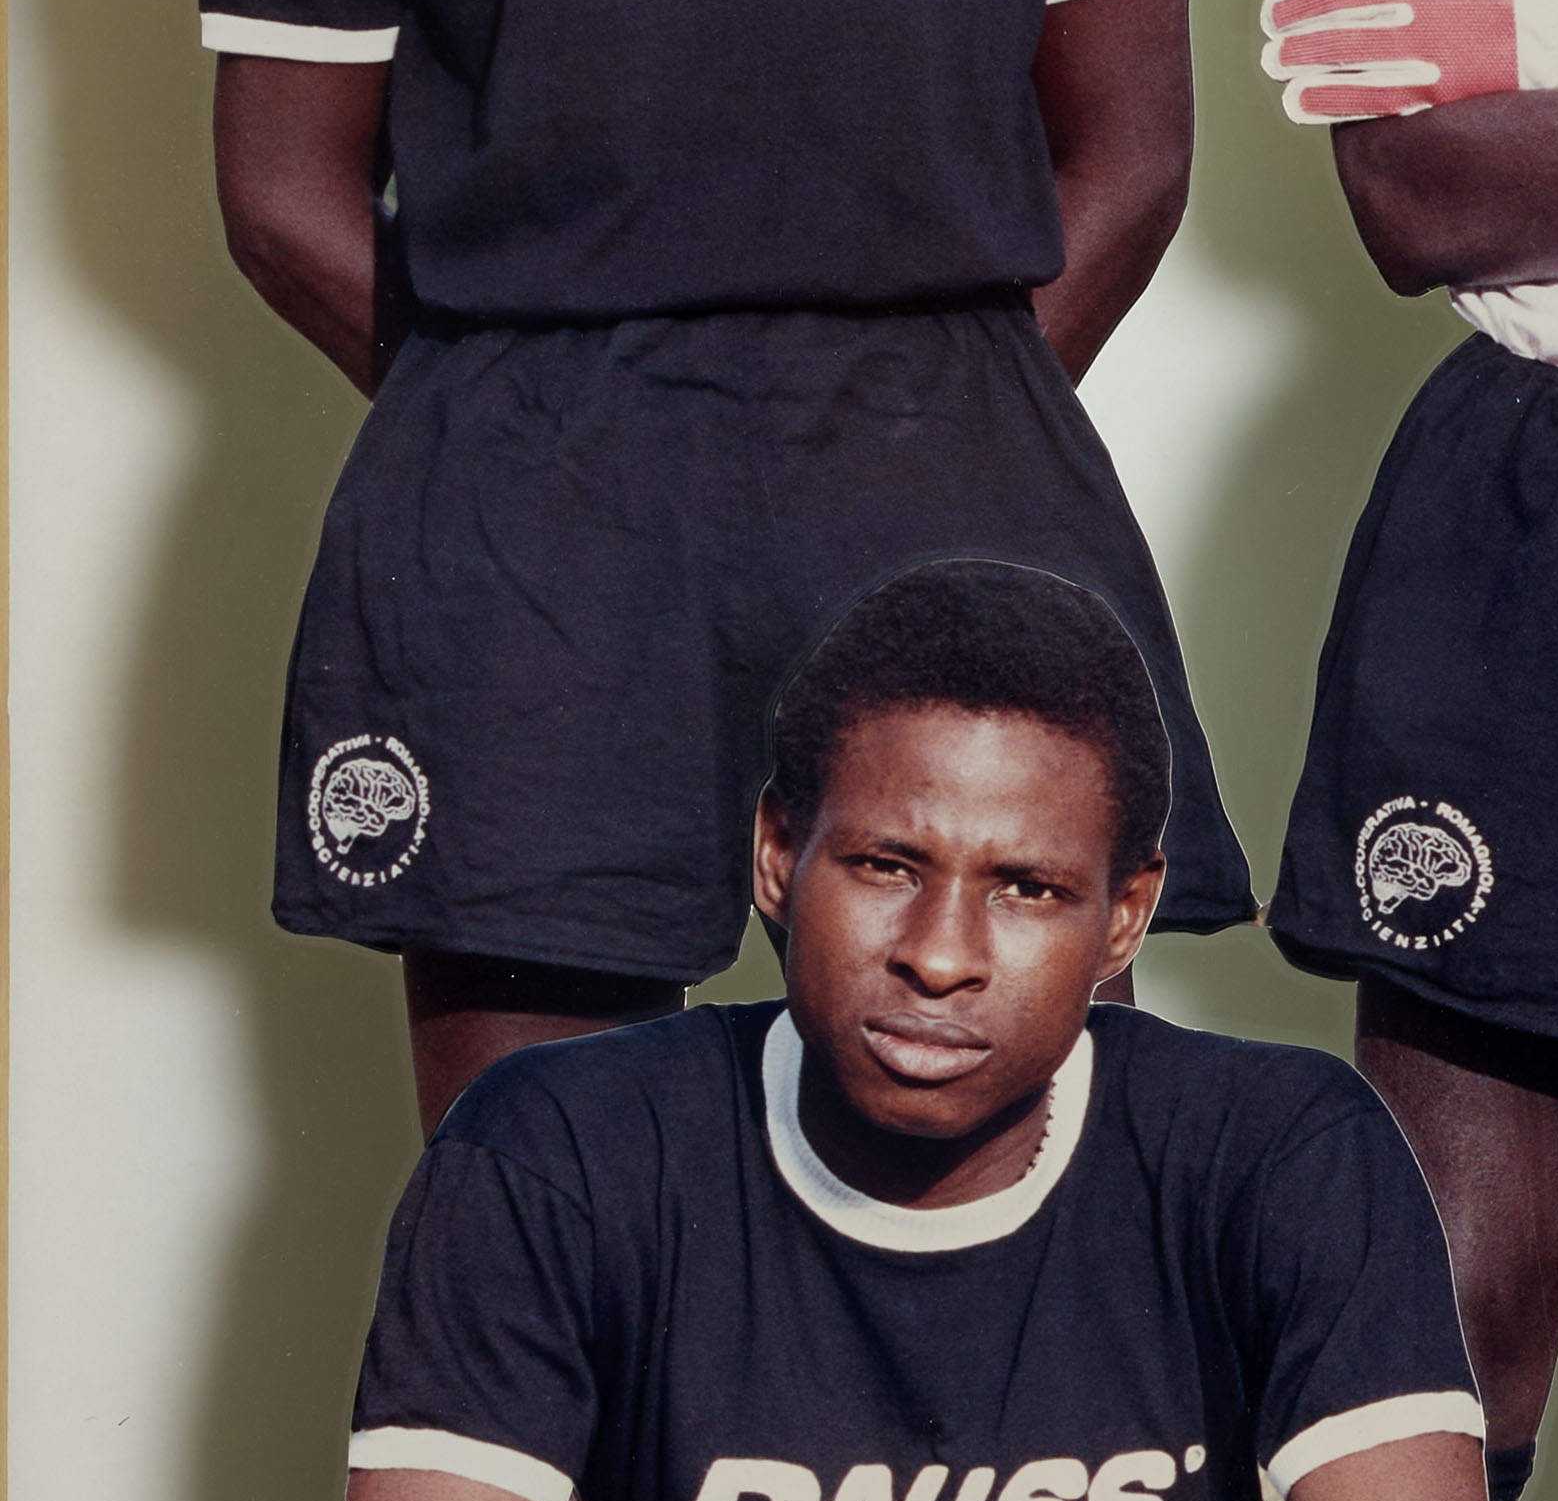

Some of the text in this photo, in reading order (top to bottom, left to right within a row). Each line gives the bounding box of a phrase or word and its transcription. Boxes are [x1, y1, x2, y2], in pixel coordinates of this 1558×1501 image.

[308, 734, 371, 831] COOPERATIVA
[386, 736, 431, 840] ROMAGNOLA
[1355, 796, 1494, 949] COOPERATIVA ROMAGNOLA SCIENZIATI
